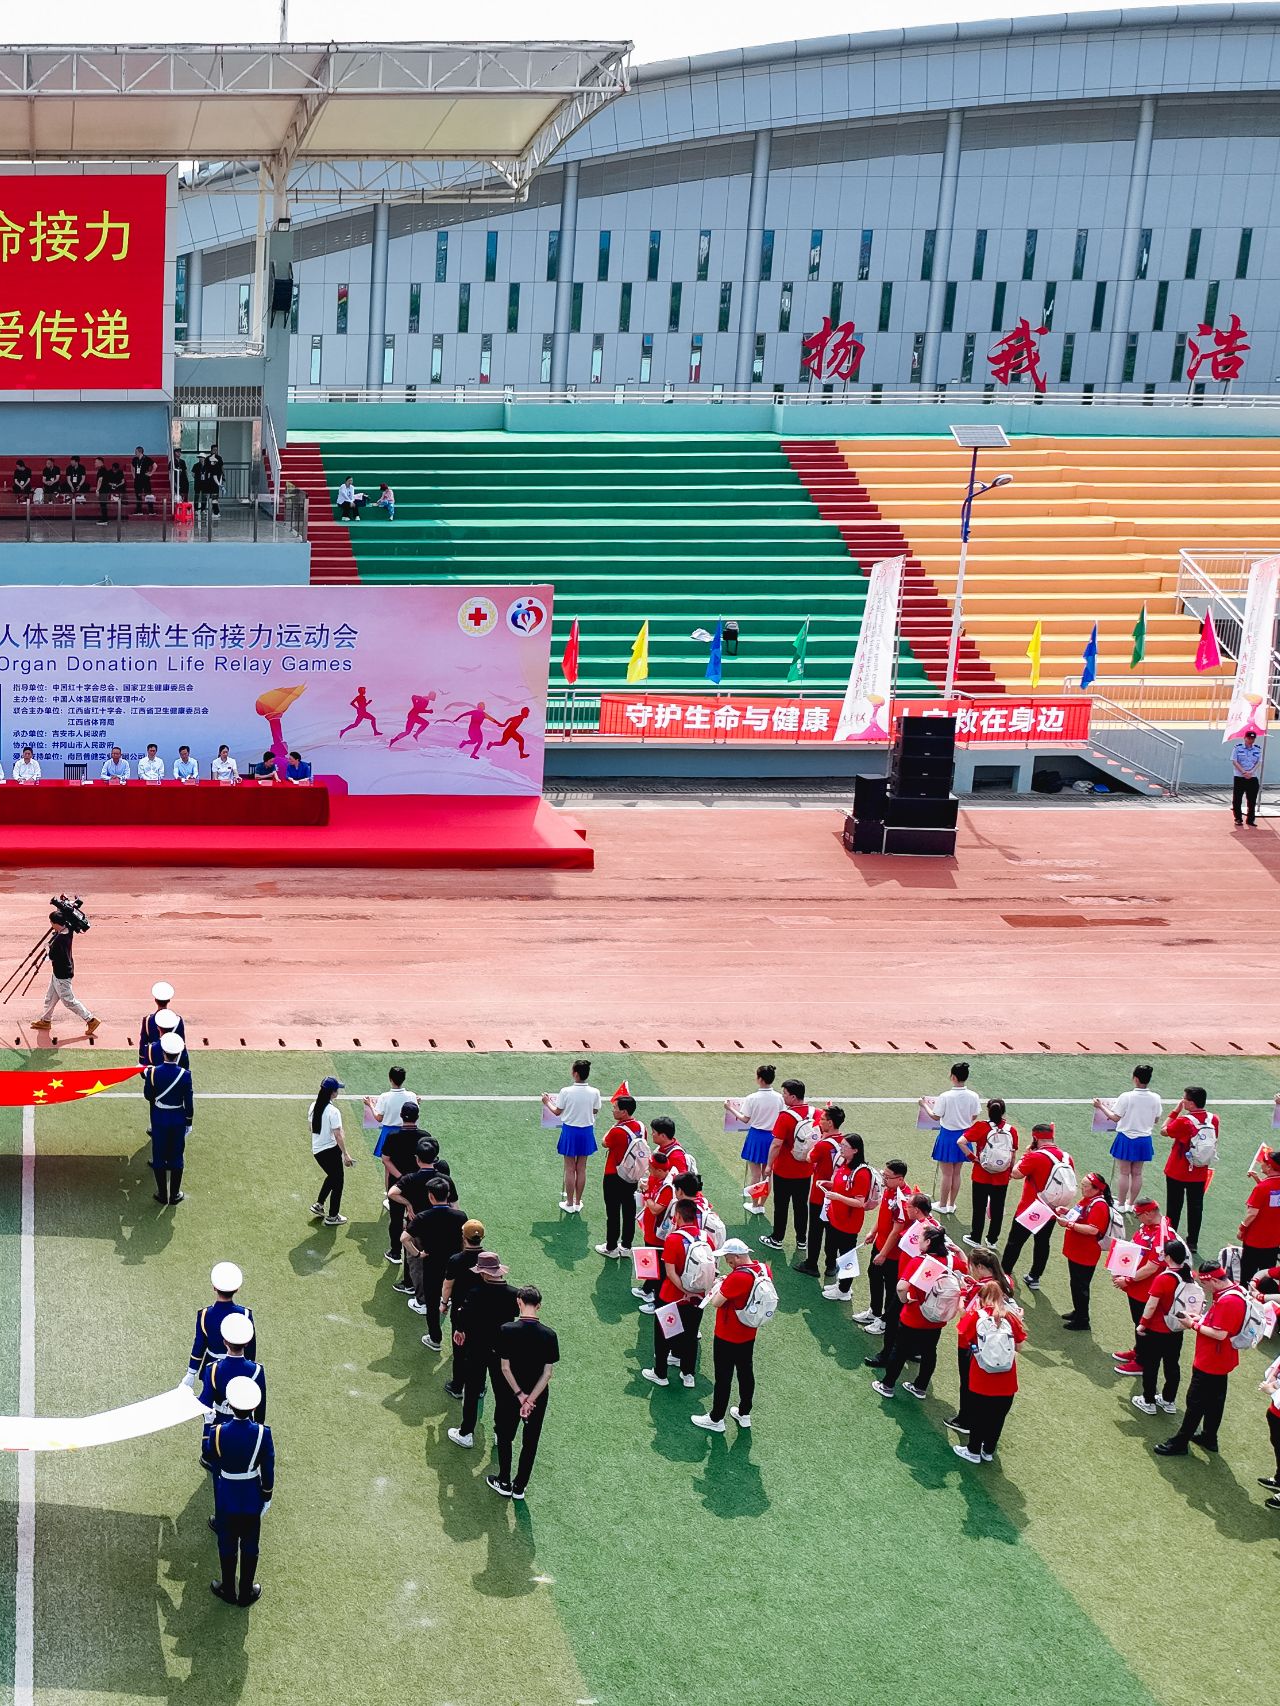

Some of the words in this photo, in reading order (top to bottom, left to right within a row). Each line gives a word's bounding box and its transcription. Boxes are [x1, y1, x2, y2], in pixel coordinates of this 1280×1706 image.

[67, 655, 158, 671] Donation
[168, 655, 205, 671] Life
[215, 655, 272, 675] Relay
[281, 655, 352, 671] Games
[67, 718, 115, 726] 江西省体育局
[625, 703, 829, 733] 守护生命与健康
